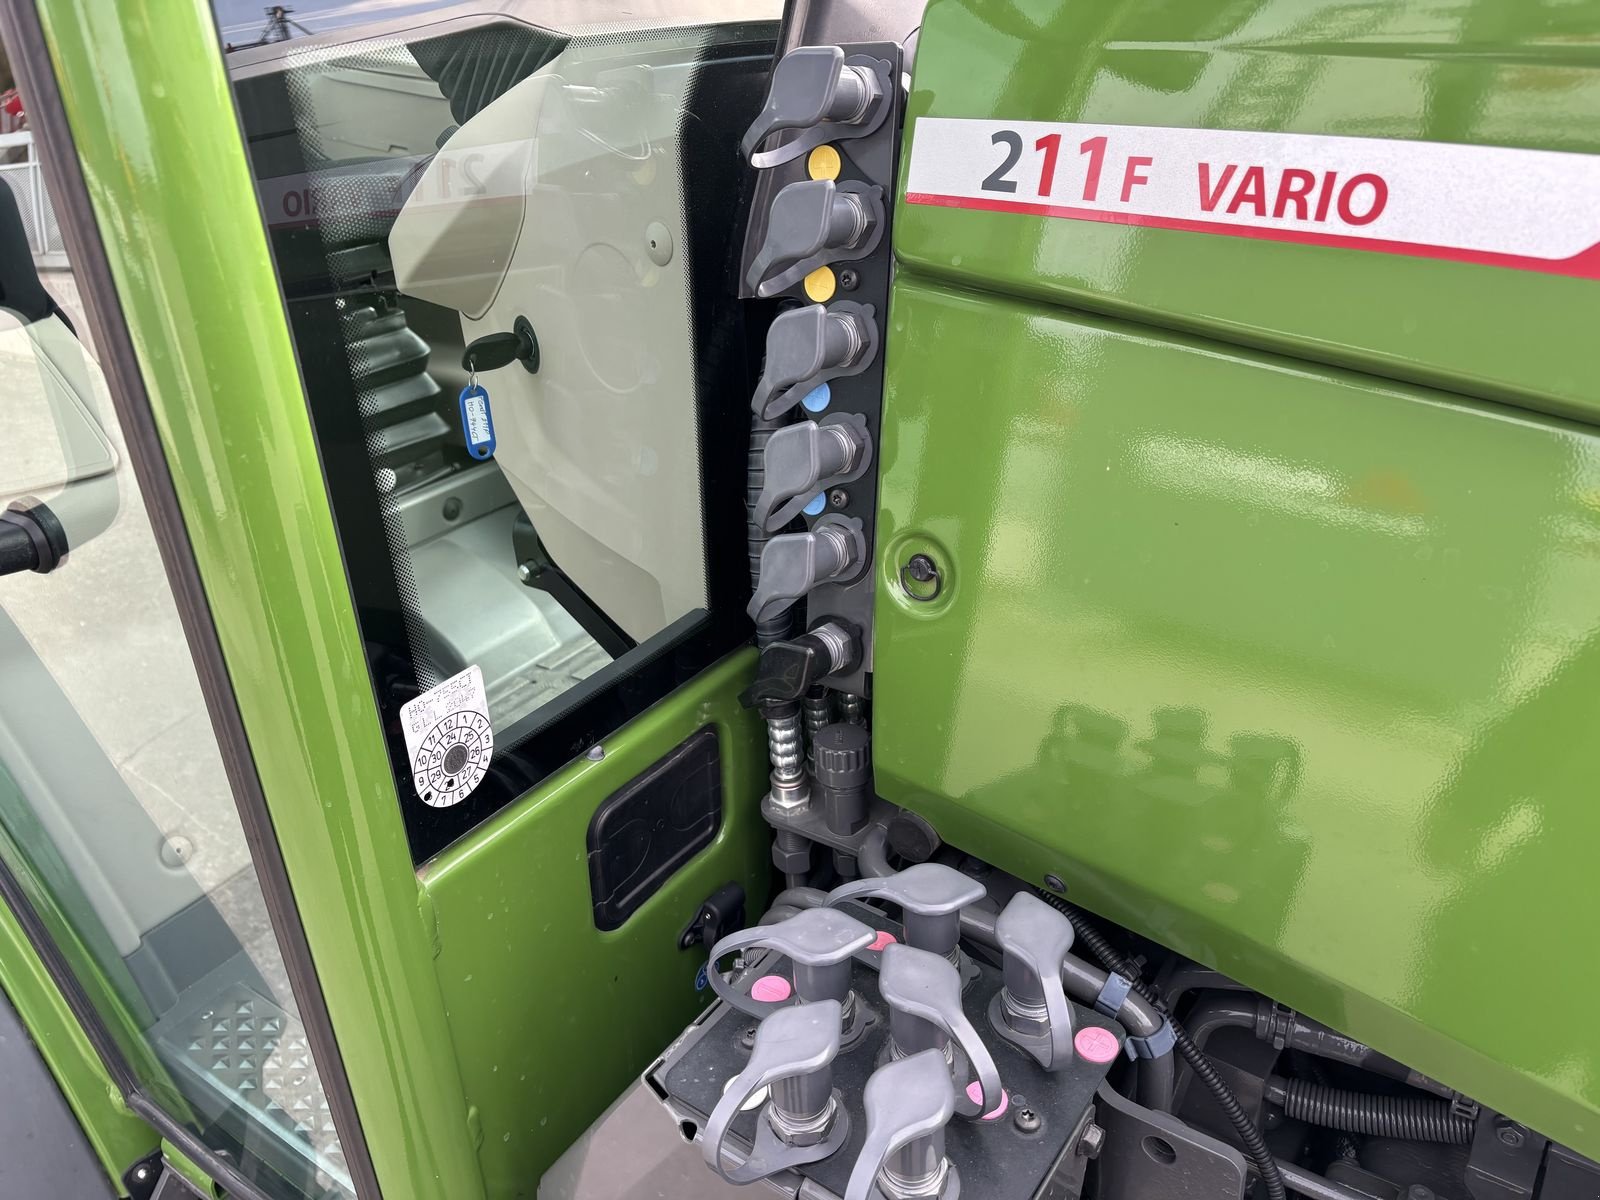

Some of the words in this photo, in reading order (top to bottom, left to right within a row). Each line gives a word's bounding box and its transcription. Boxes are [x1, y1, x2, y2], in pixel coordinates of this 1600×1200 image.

[1197, 162, 1389, 226] VARIO
[462, 714, 468, 723] 1
[477, 719, 484, 729] 2
[443, 719, 454, 731] 12
[427, 734, 436, 746] 11
[445, 732, 457, 744] 24
[463, 731, 475, 743] 25
[485, 734, 490, 744] 3
[431, 750, 442, 763] 30
[470, 746, 480, 760] 26
[482, 754, 489, 763] 4
[417, 755, 427, 767] 10
[430, 771, 442, 784] 29
[461, 766, 472, 780] 27
[418, 776, 425, 787] 9
[474, 775, 480, 784] 5
[441, 795, 448, 806] 7
[458, 790, 465, 799] 6
